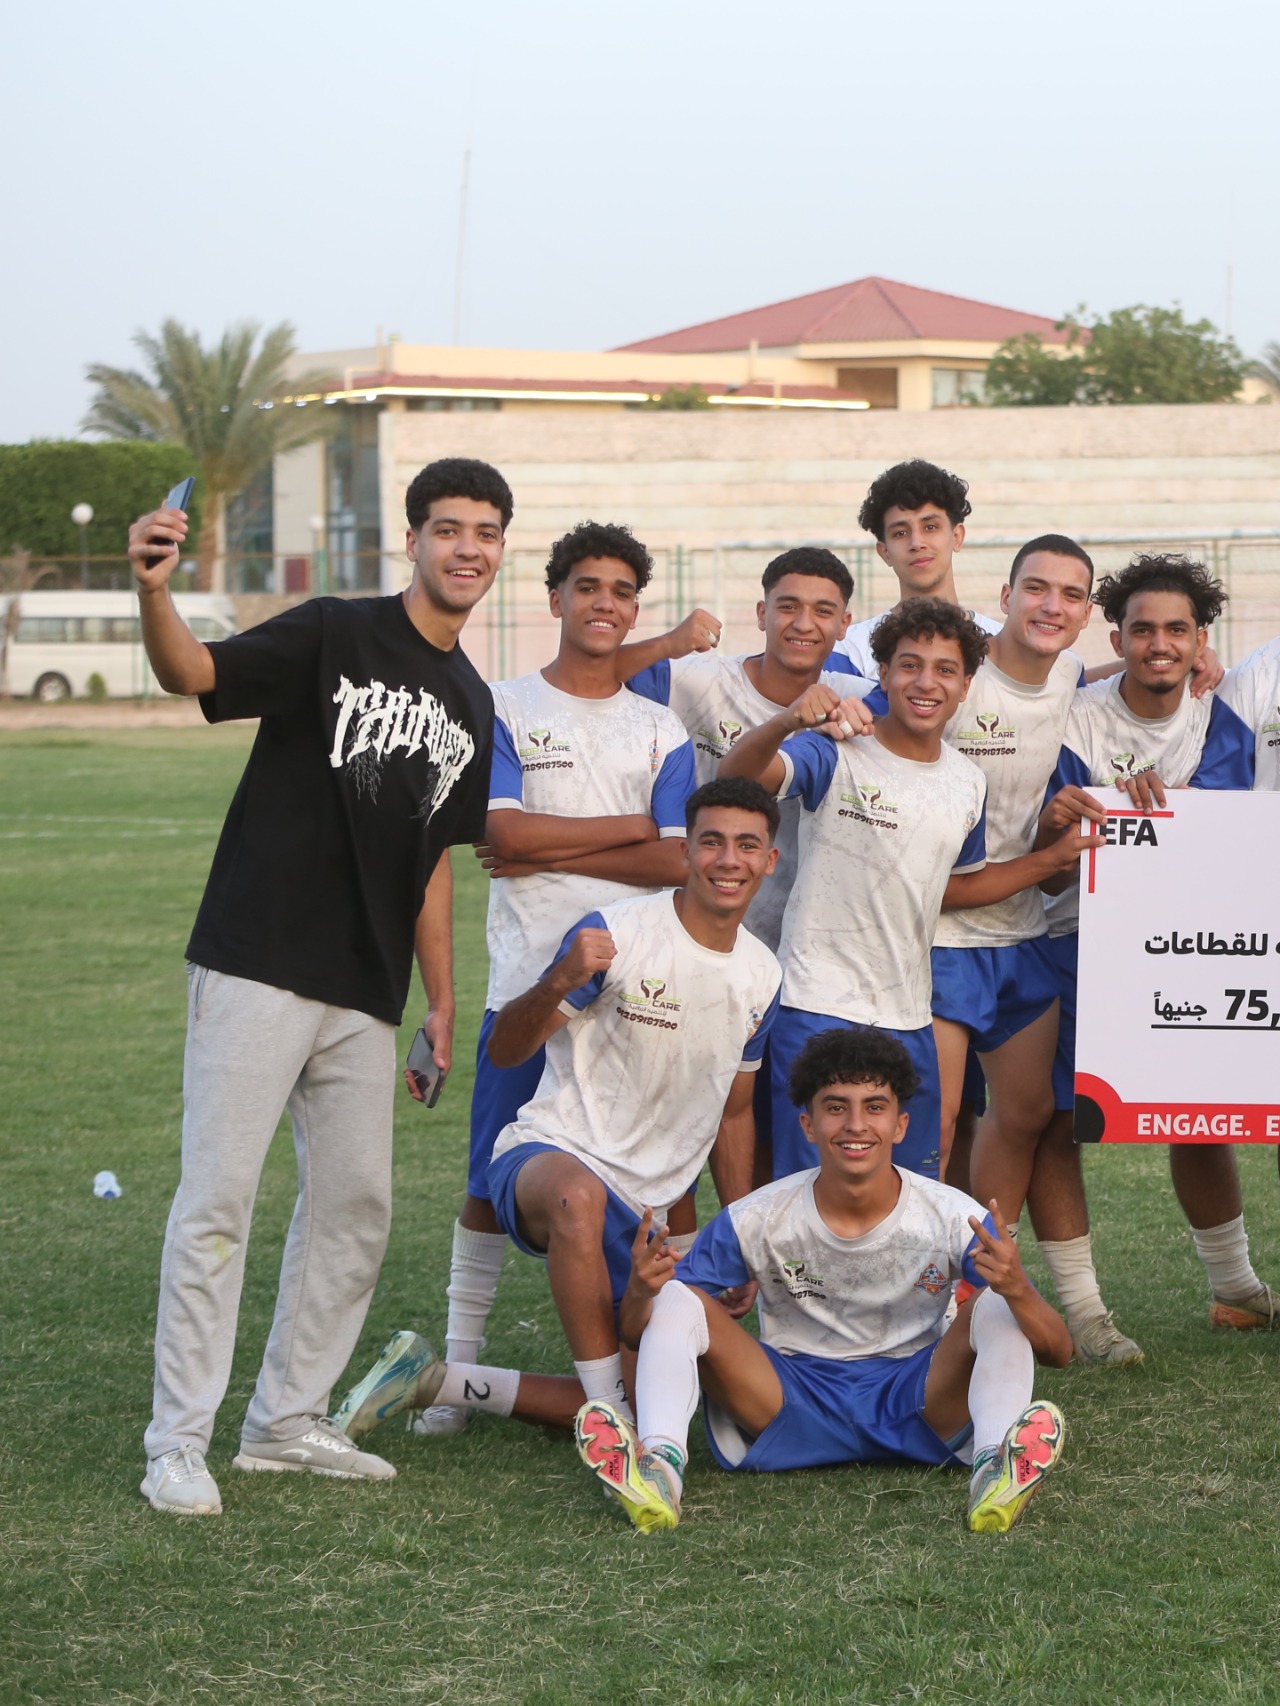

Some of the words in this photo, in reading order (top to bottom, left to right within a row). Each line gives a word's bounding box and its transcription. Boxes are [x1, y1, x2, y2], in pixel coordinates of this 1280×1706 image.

[991, 731, 1016, 739] CARE
[958, 747, 1017, 756] 01289187500
[522, 760, 574, 771] 1289187500
[870, 803, 898, 813] CARE
[838, 808, 898, 830] 01289187500
[1099, 818, 1158, 847] EFA
[1144, 931, 1269, 957] للقطاعات
[652, 1000, 681, 1012] CARE
[616, 1006, 678, 1030] 01289187500
[1137, 1113, 1251, 1137] ENGAGE.
[796, 1276, 825, 1287] CARE
[464, 1379, 491, 1401] 2
